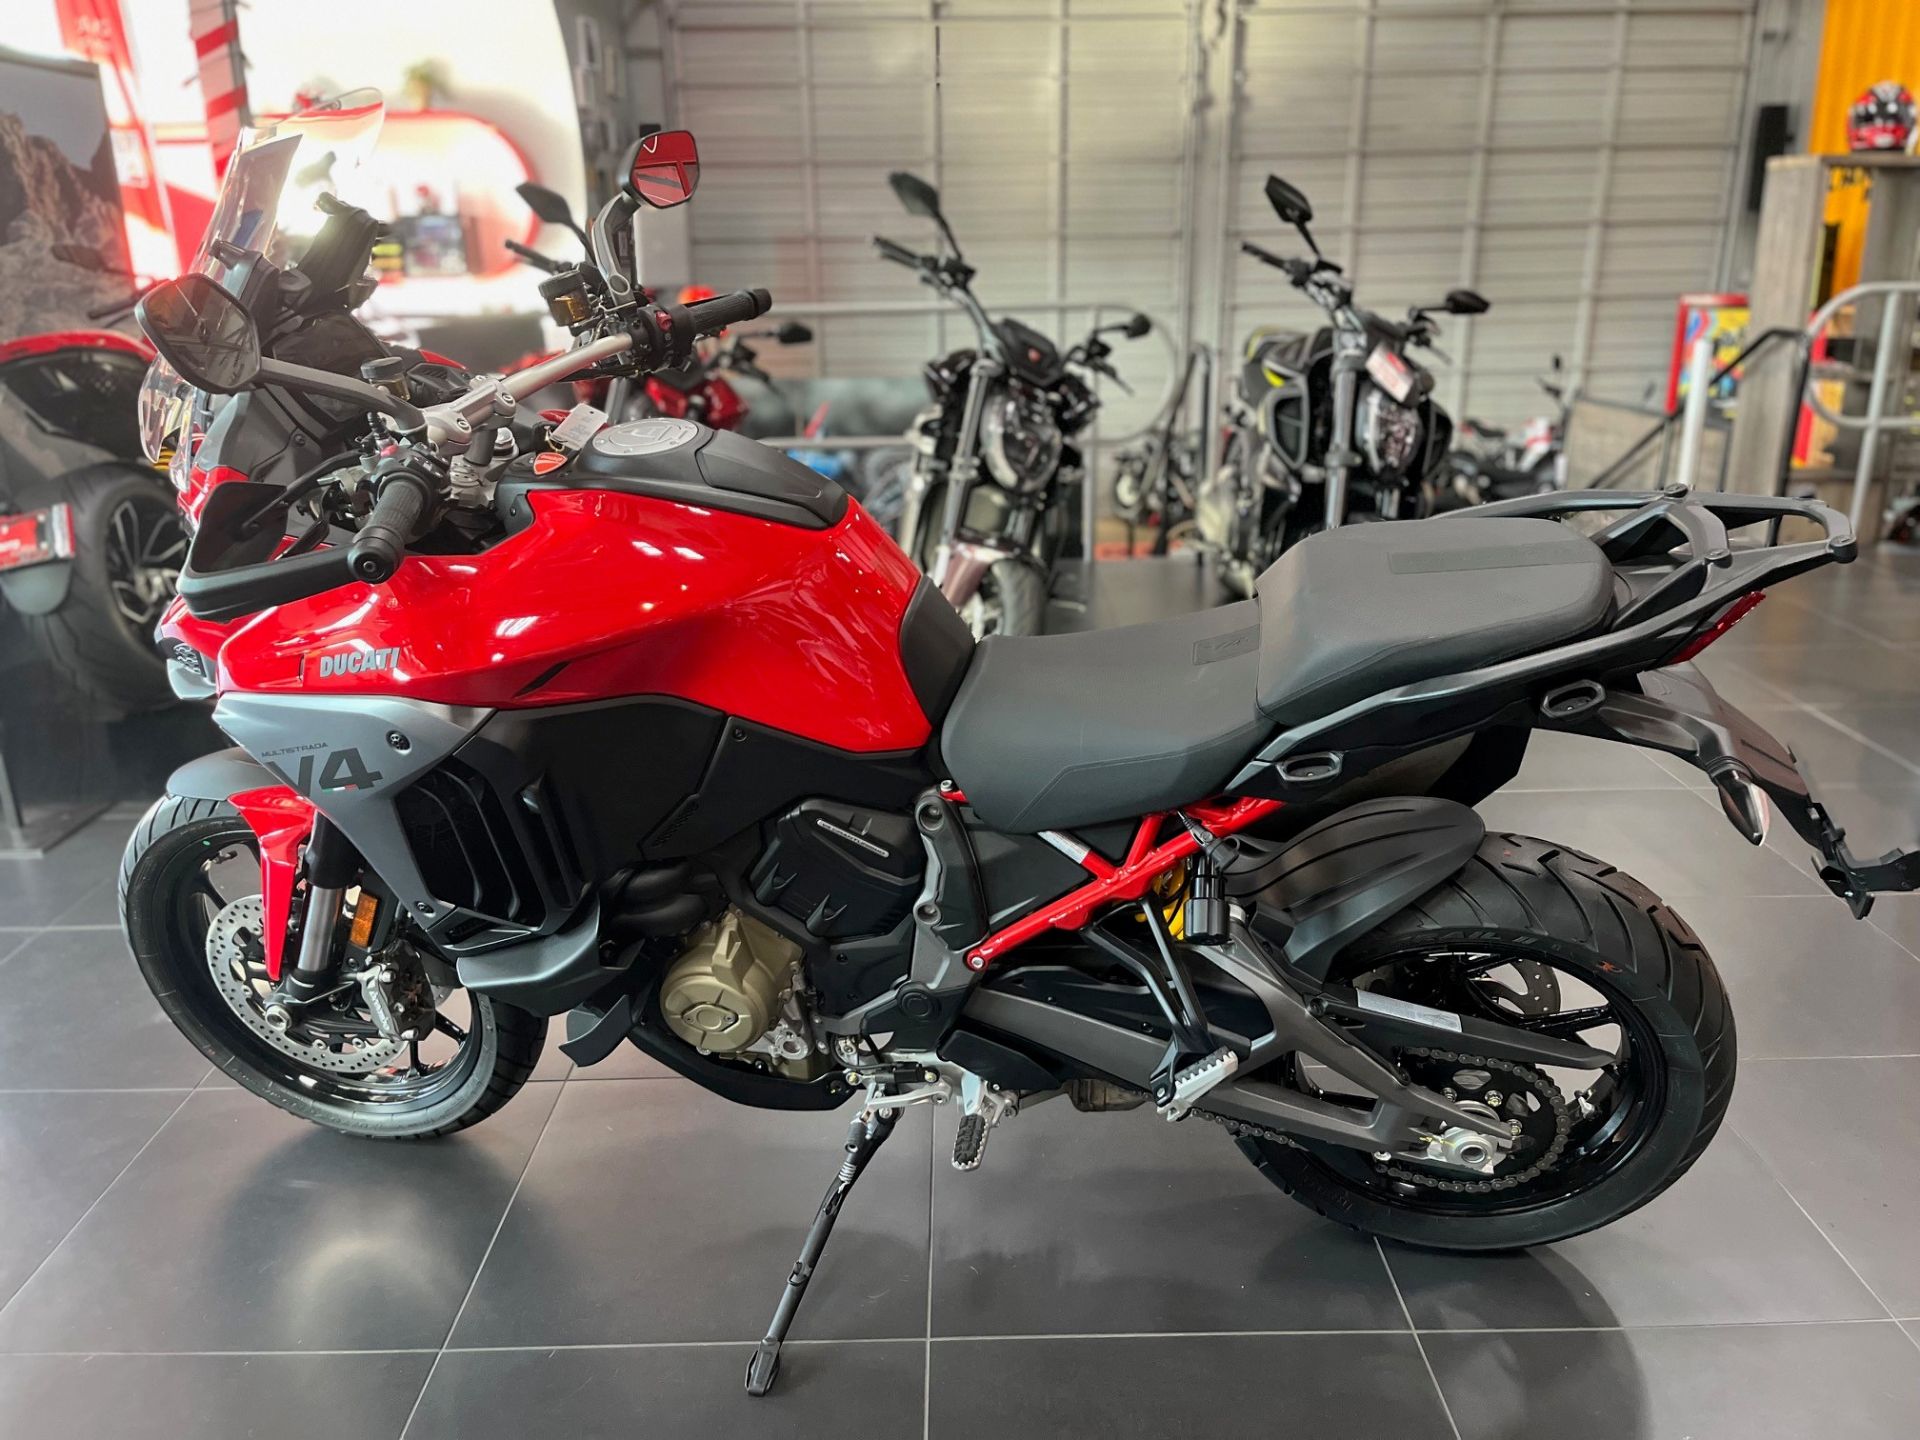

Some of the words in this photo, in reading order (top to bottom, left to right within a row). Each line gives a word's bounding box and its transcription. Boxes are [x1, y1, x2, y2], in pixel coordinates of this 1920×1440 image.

[320, 647, 400, 677] DUCATI
[262, 742, 329, 758] MULTISTRADA
[264, 748, 383, 797] V4
